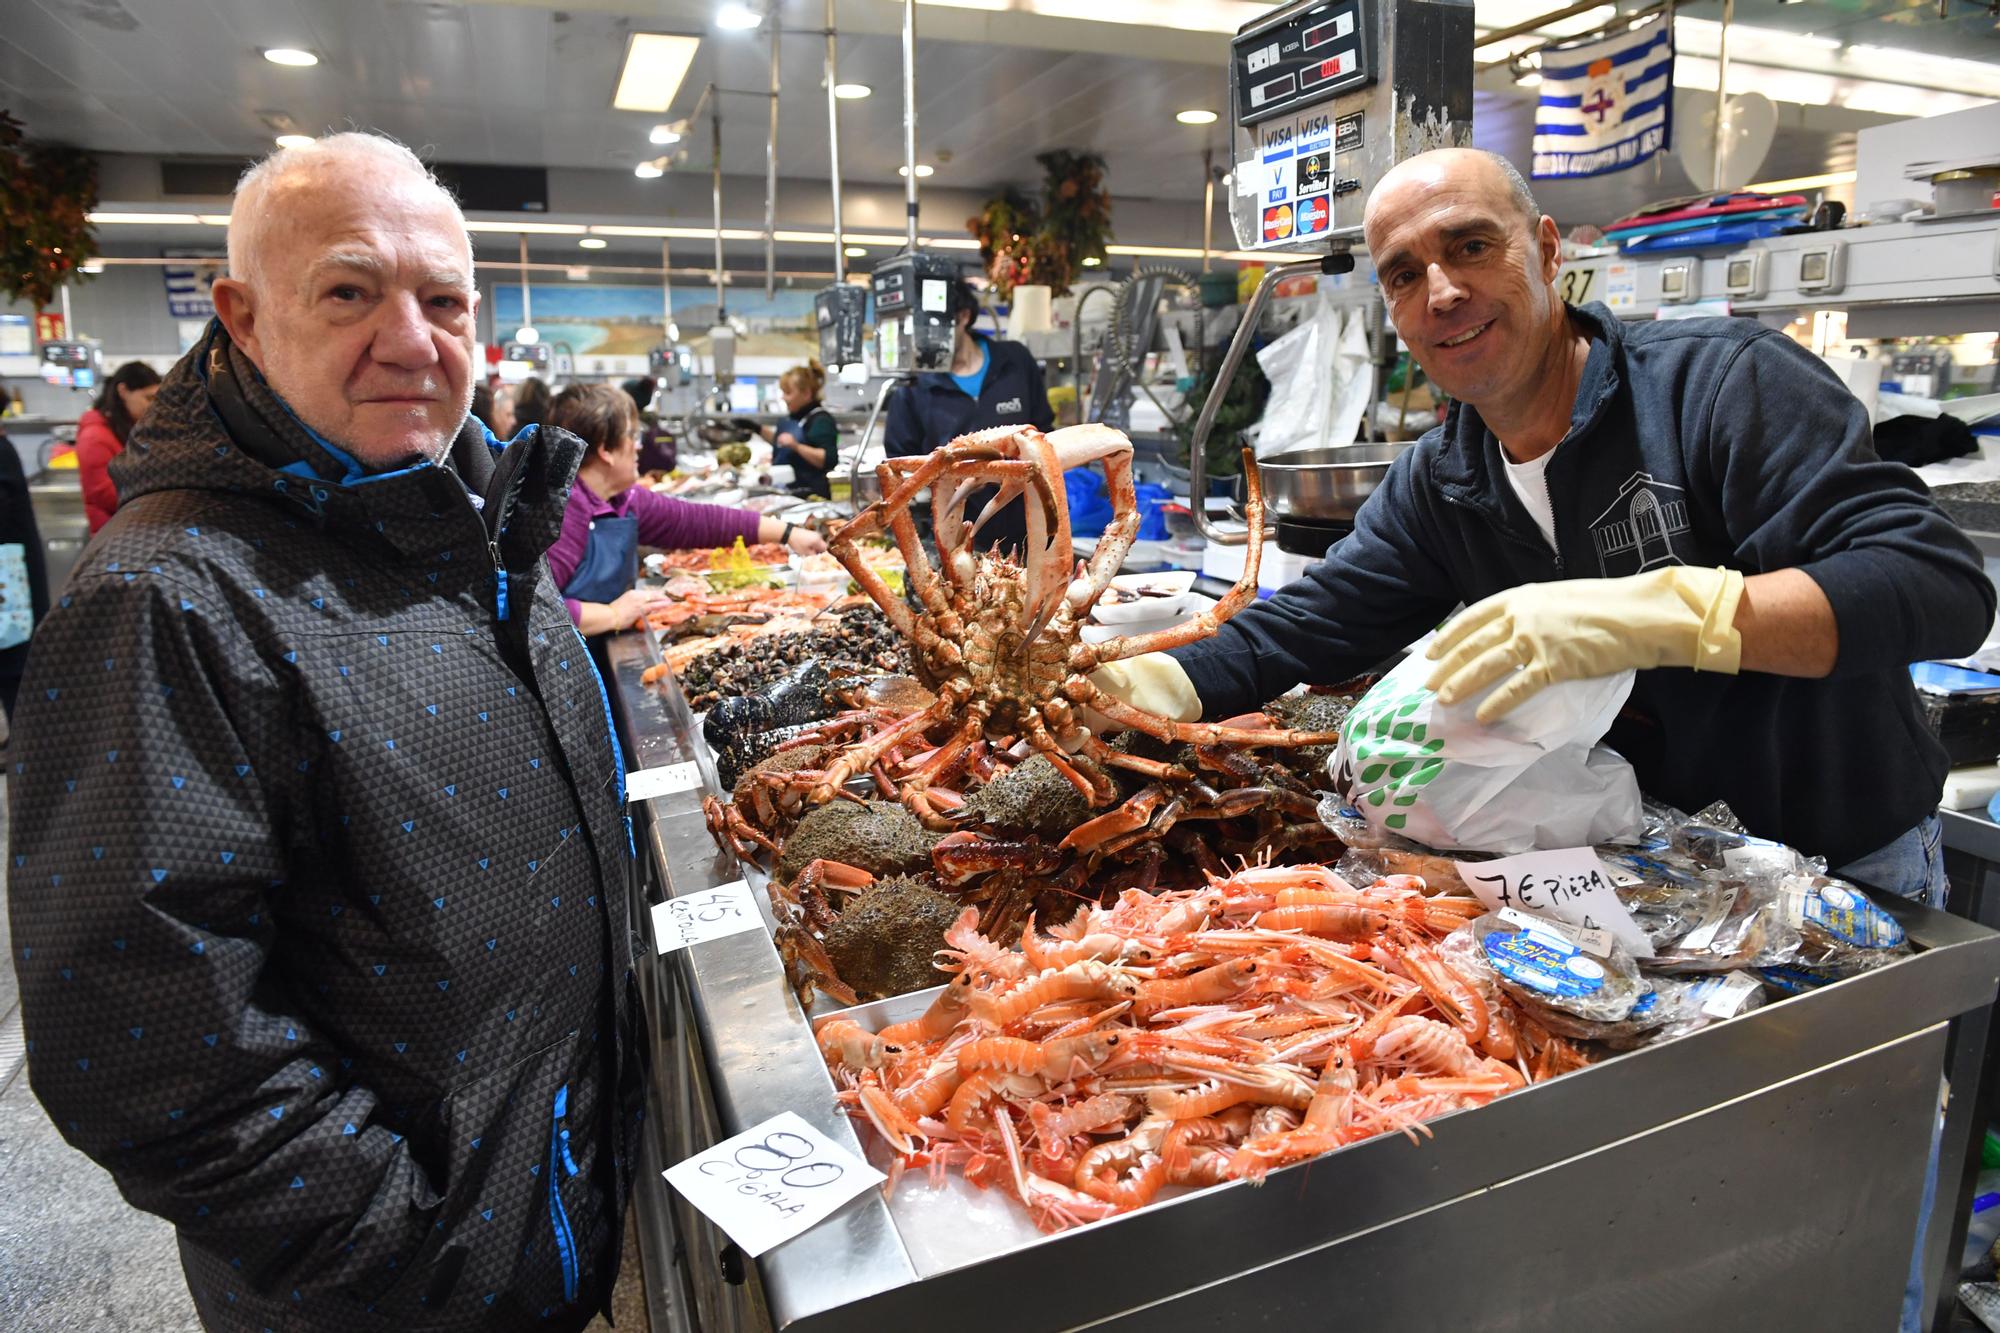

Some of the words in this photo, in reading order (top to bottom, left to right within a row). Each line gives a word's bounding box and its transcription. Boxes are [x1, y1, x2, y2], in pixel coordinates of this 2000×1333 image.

[1266, 126, 1293, 149] VISA
[1301, 115, 1329, 139] VISA
[1273, 166, 1283, 186] V
[1298, 176, 1328, 195] ServiRed
[1271, 189, 1285, 201] PAY
[1300, 209, 1327, 222] Maestro
[697, 894, 742, 922] 45
[669, 899, 700, 943] CENTOLLA
[734, 1132, 844, 1188] 80
[699, 1160, 805, 1220] CIGALA
